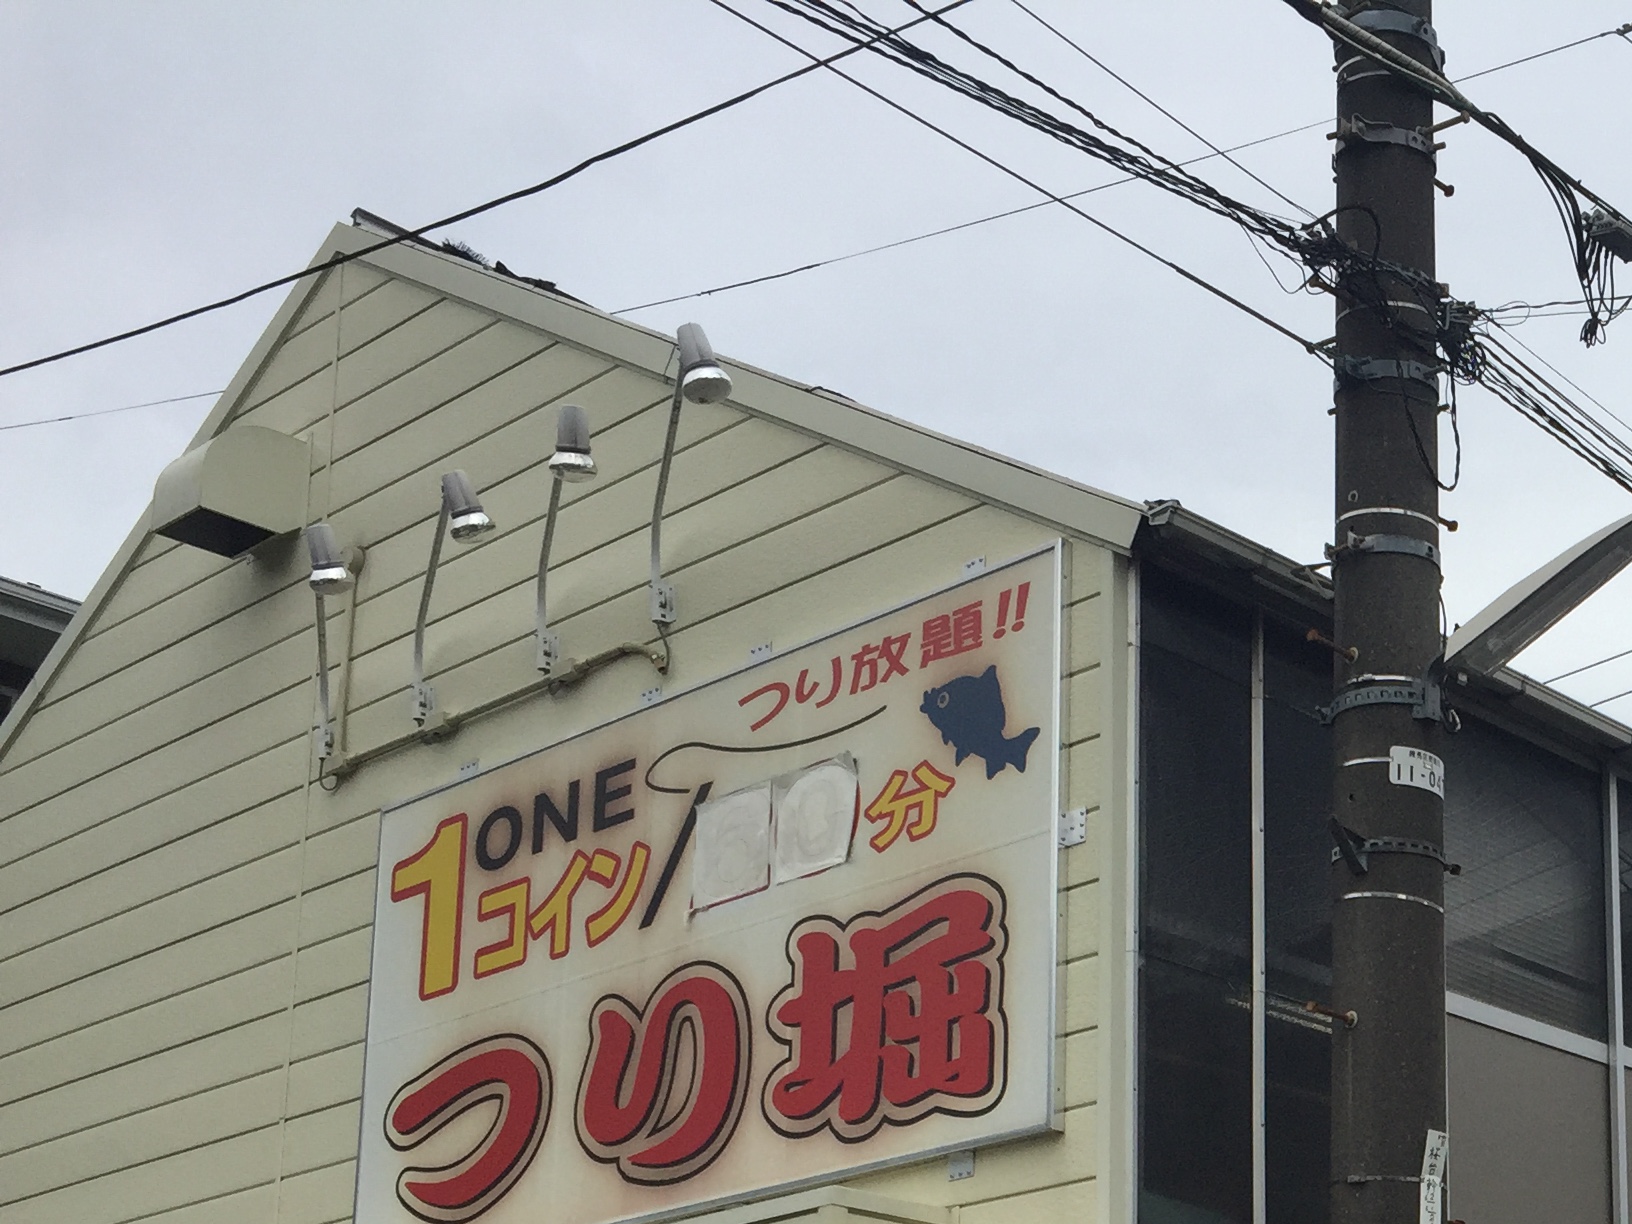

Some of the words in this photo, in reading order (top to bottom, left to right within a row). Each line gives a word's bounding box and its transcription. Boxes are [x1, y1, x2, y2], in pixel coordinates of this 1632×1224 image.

[737, 581, 1033, 732] つり放題!!
[474, 758, 637, 872] ONE
